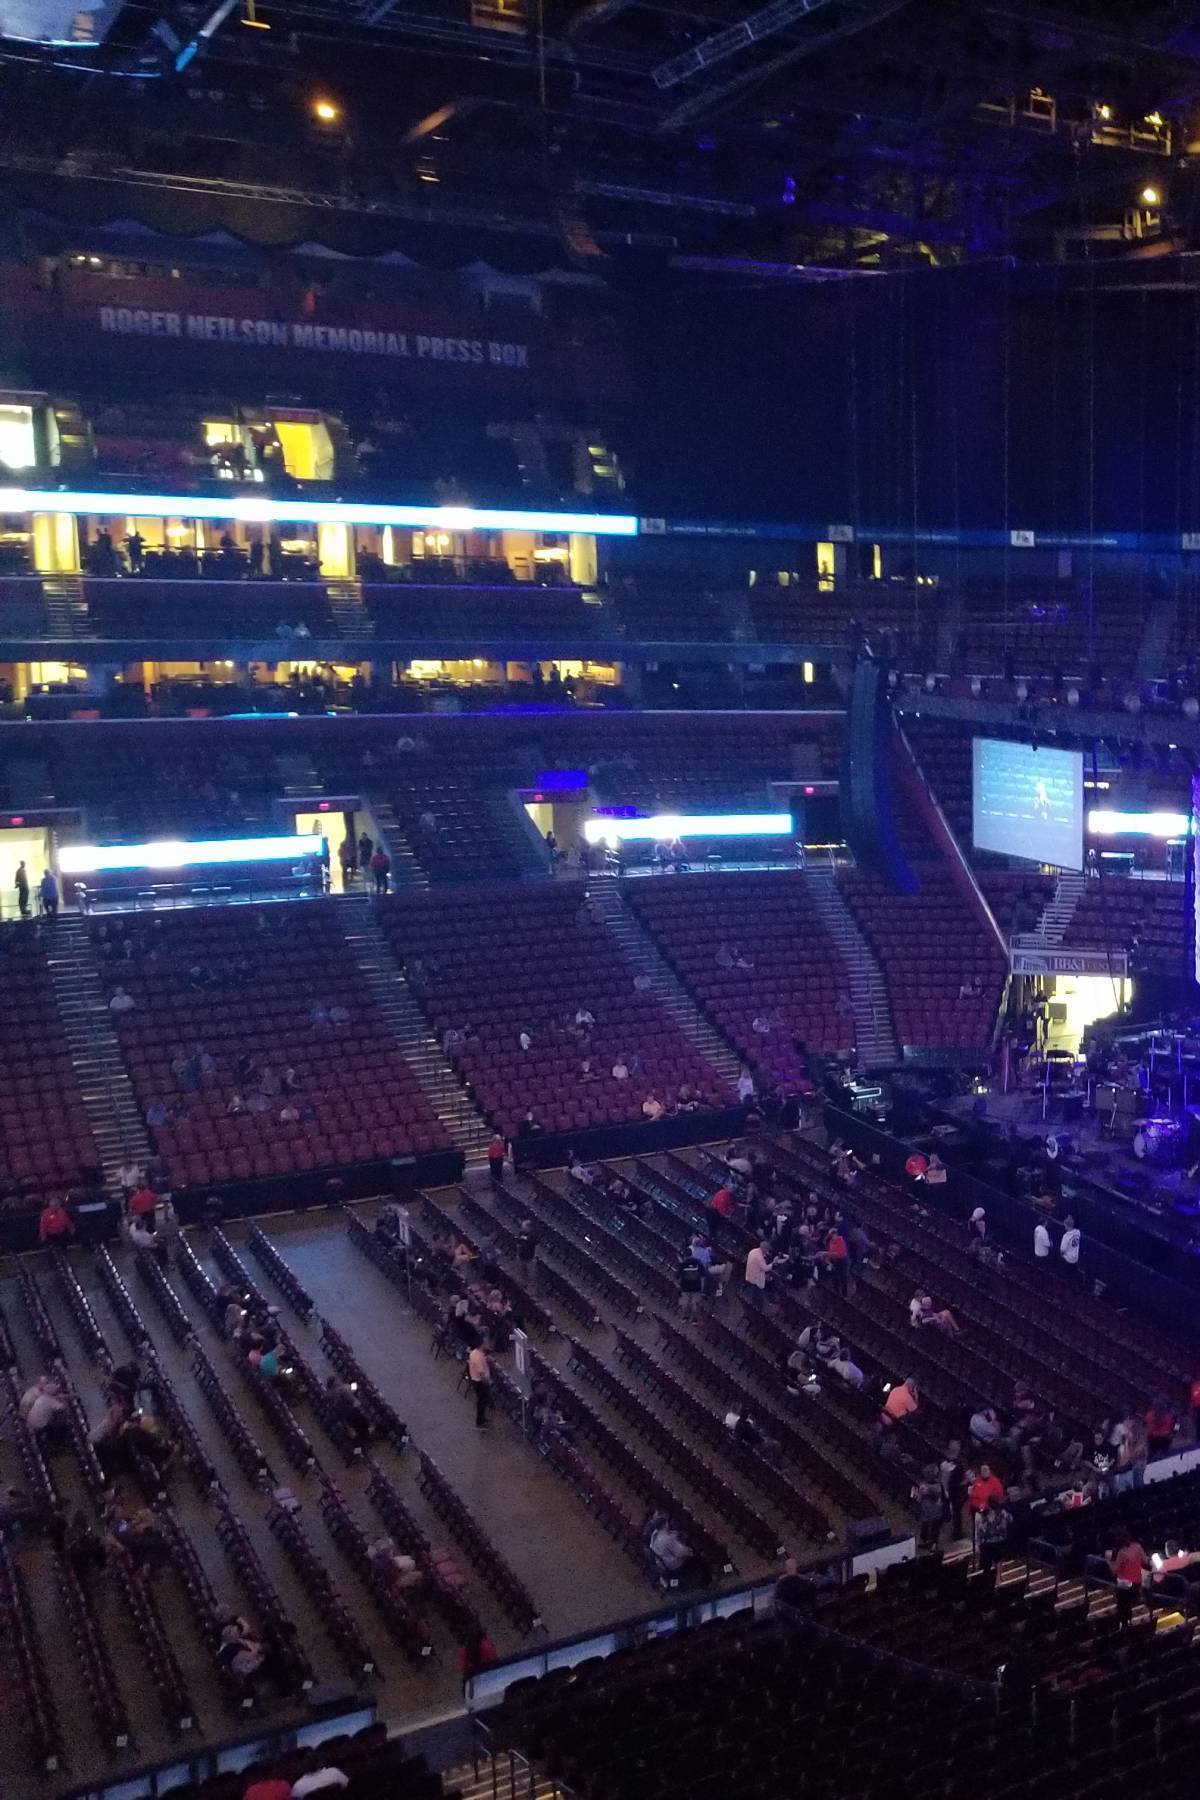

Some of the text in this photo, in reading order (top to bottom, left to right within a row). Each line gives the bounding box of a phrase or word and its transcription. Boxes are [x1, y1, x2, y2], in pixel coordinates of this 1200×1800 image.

[99, 306, 530, 369] ROGER NEILSON MEMORIAL PRESS BOX
